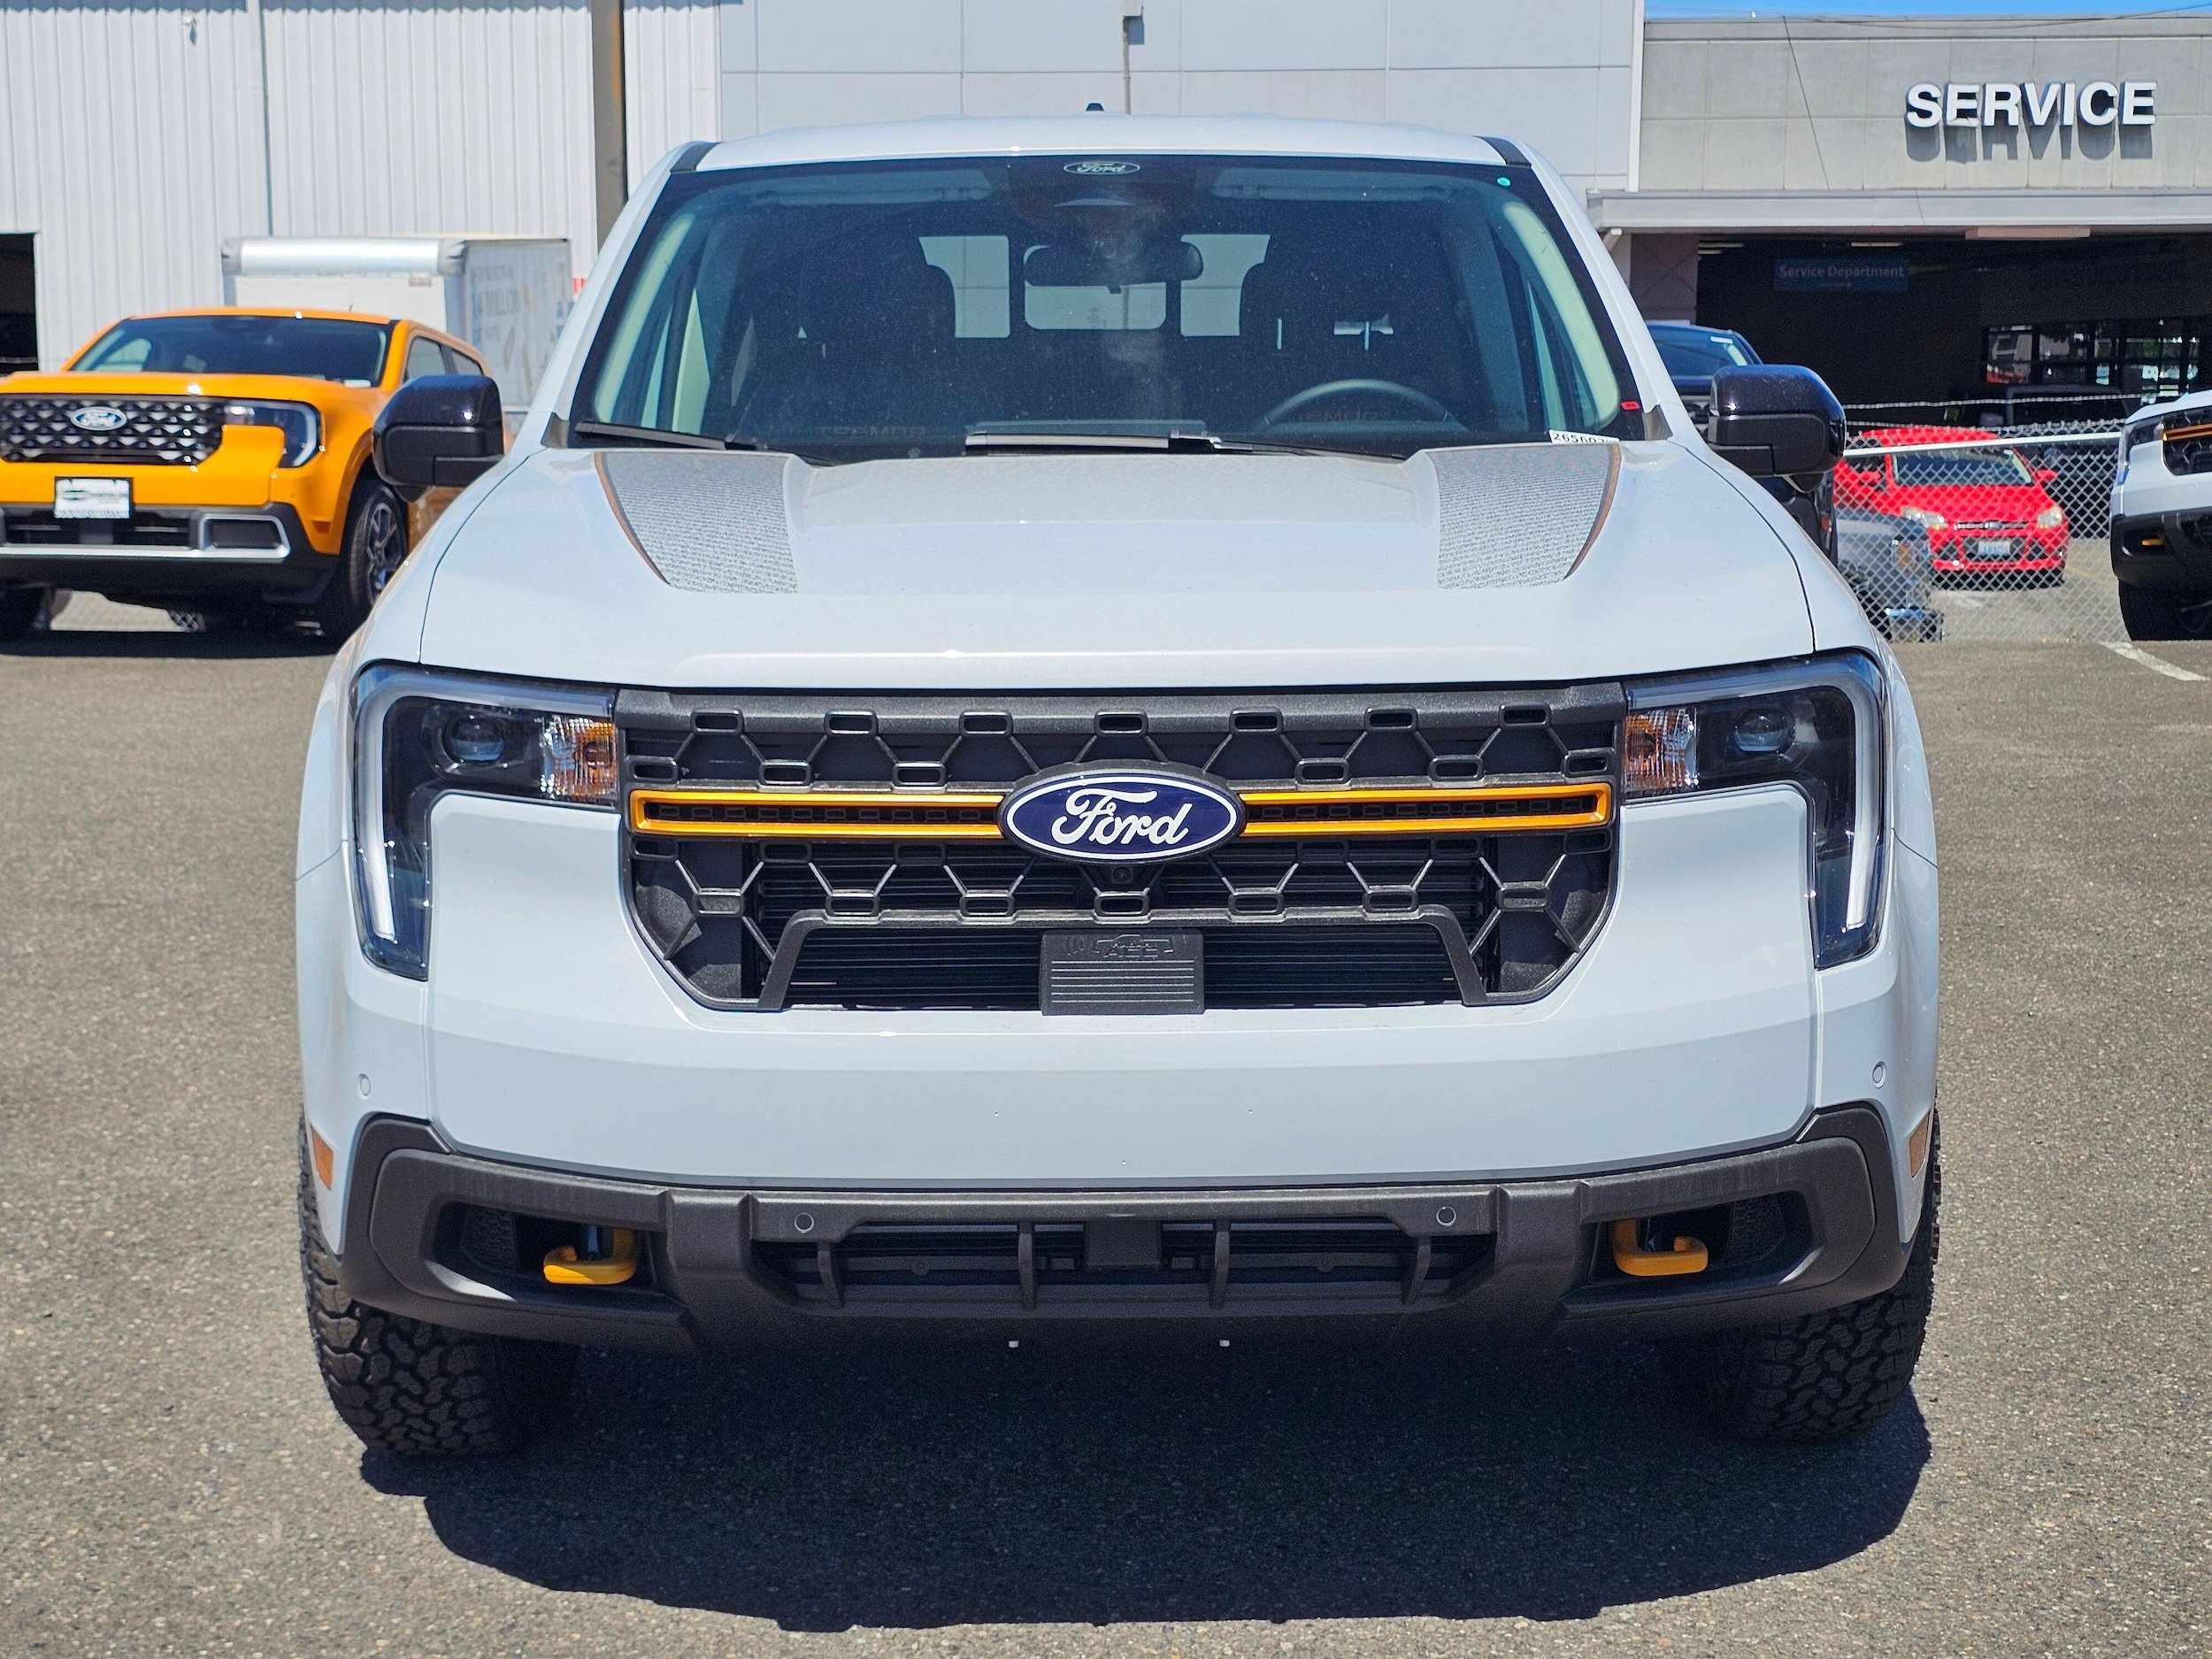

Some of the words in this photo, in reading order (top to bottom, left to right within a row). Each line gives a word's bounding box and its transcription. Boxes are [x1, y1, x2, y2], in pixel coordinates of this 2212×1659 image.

[1905, 81, 2157, 127] SERVICE
[1077, 163, 1126, 173] Ford
[1778, 264, 1825, 278] Service
[1827, 265, 1905, 280] Department
[1051, 787, 1193, 844] Ford
